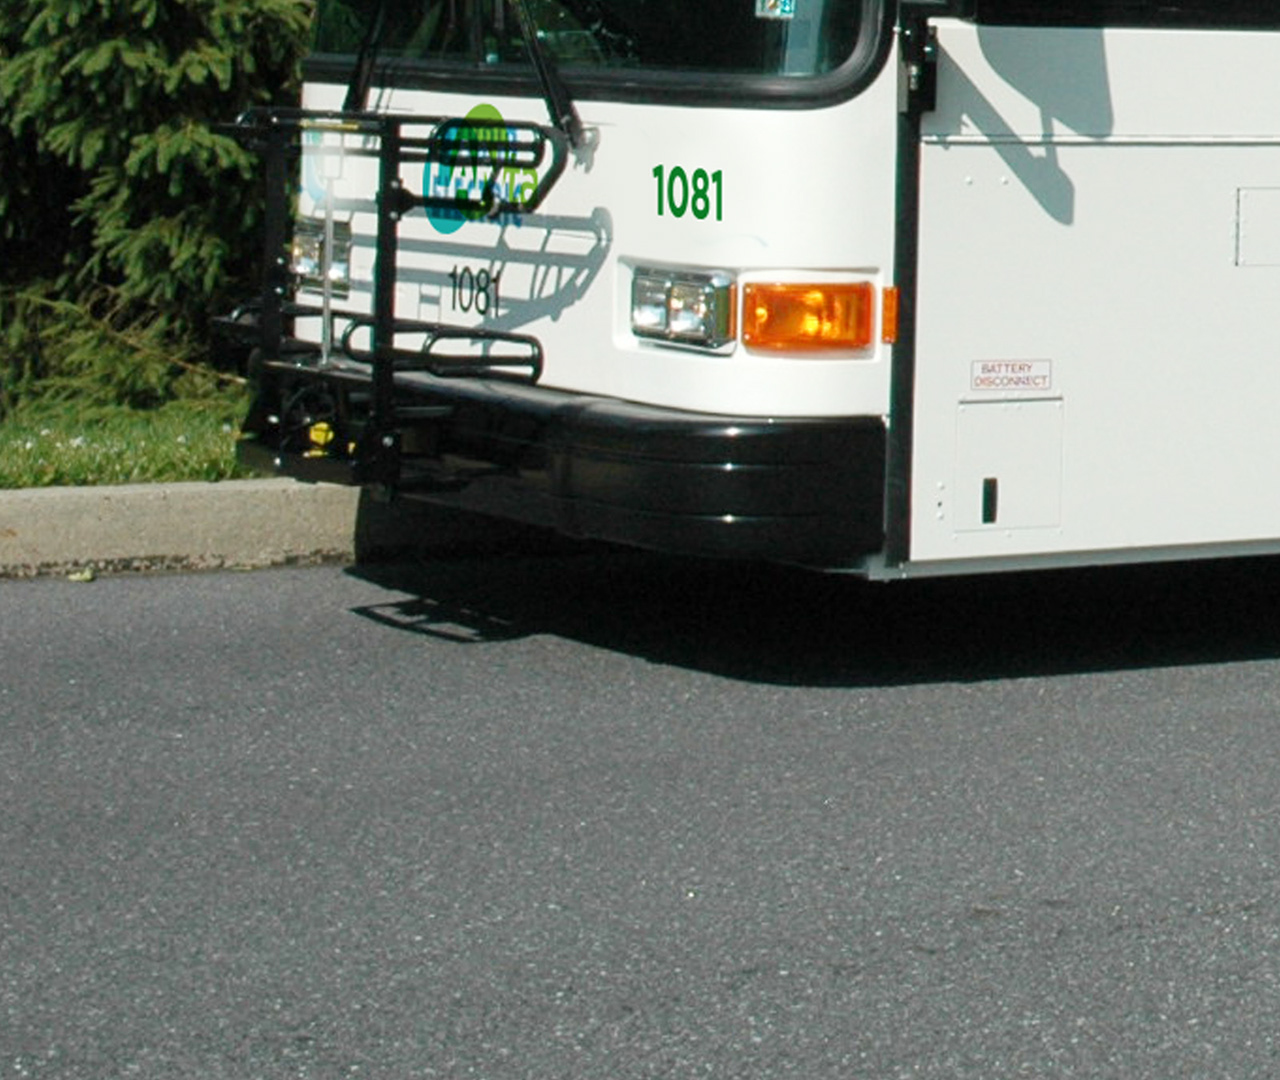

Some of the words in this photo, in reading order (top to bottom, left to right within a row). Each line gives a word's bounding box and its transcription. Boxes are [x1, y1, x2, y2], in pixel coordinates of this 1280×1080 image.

[652, 163, 723, 222] 1081
[448, 264, 501, 318] 1081
[974, 375, 1048, 387] DISCONNECT
[981, 363, 1033, 374] BATTERY
